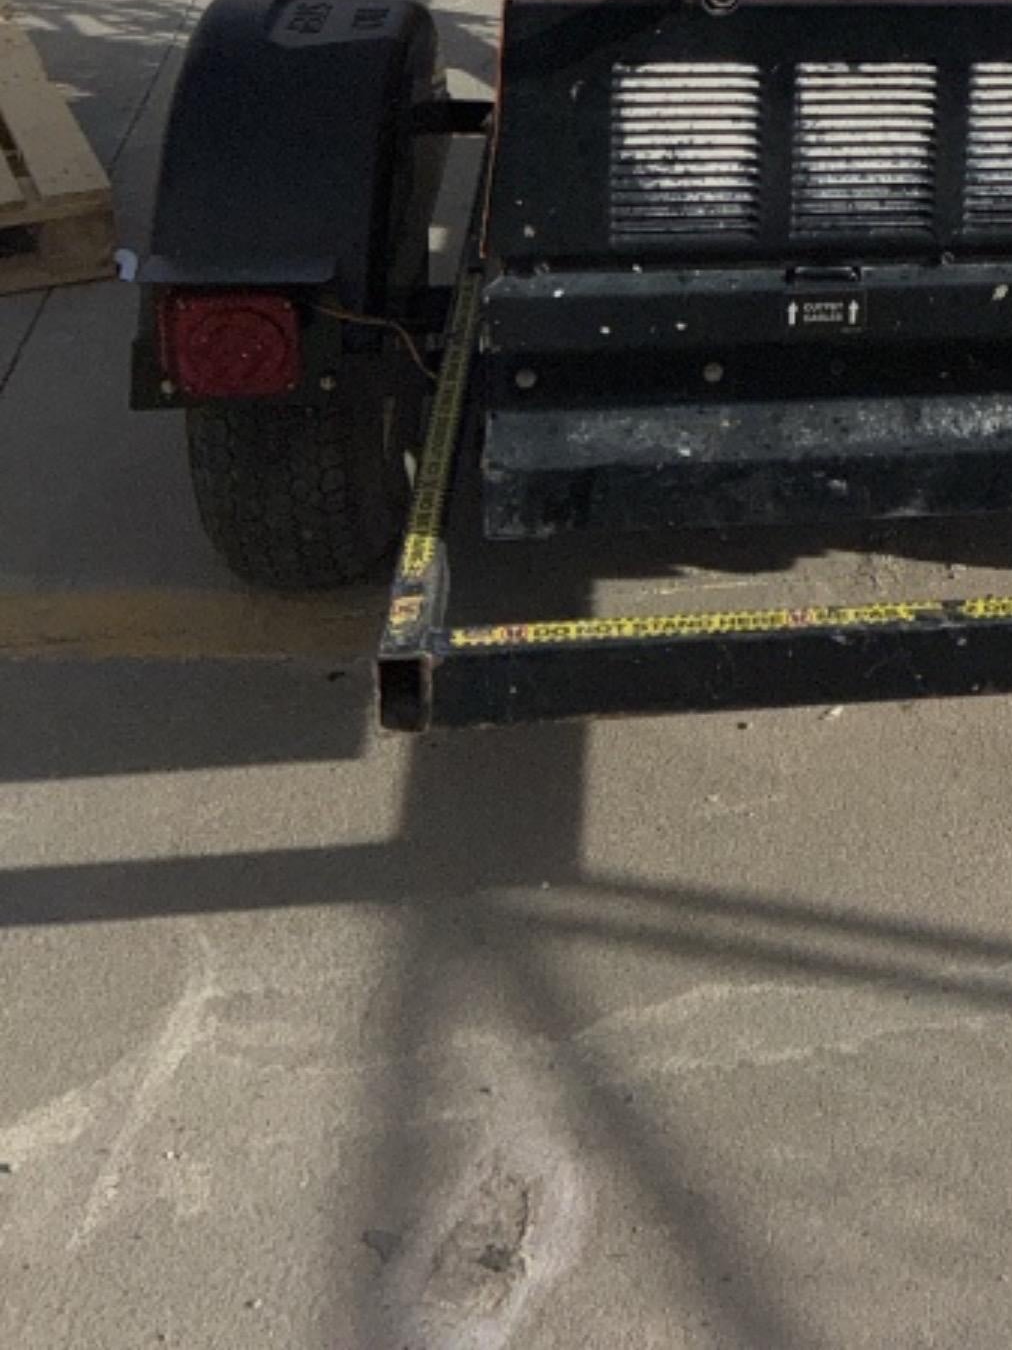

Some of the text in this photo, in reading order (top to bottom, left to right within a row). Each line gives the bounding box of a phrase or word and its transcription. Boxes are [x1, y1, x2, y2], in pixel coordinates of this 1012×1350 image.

[532, 614, 787, 638] DO NOT STAND HERE
